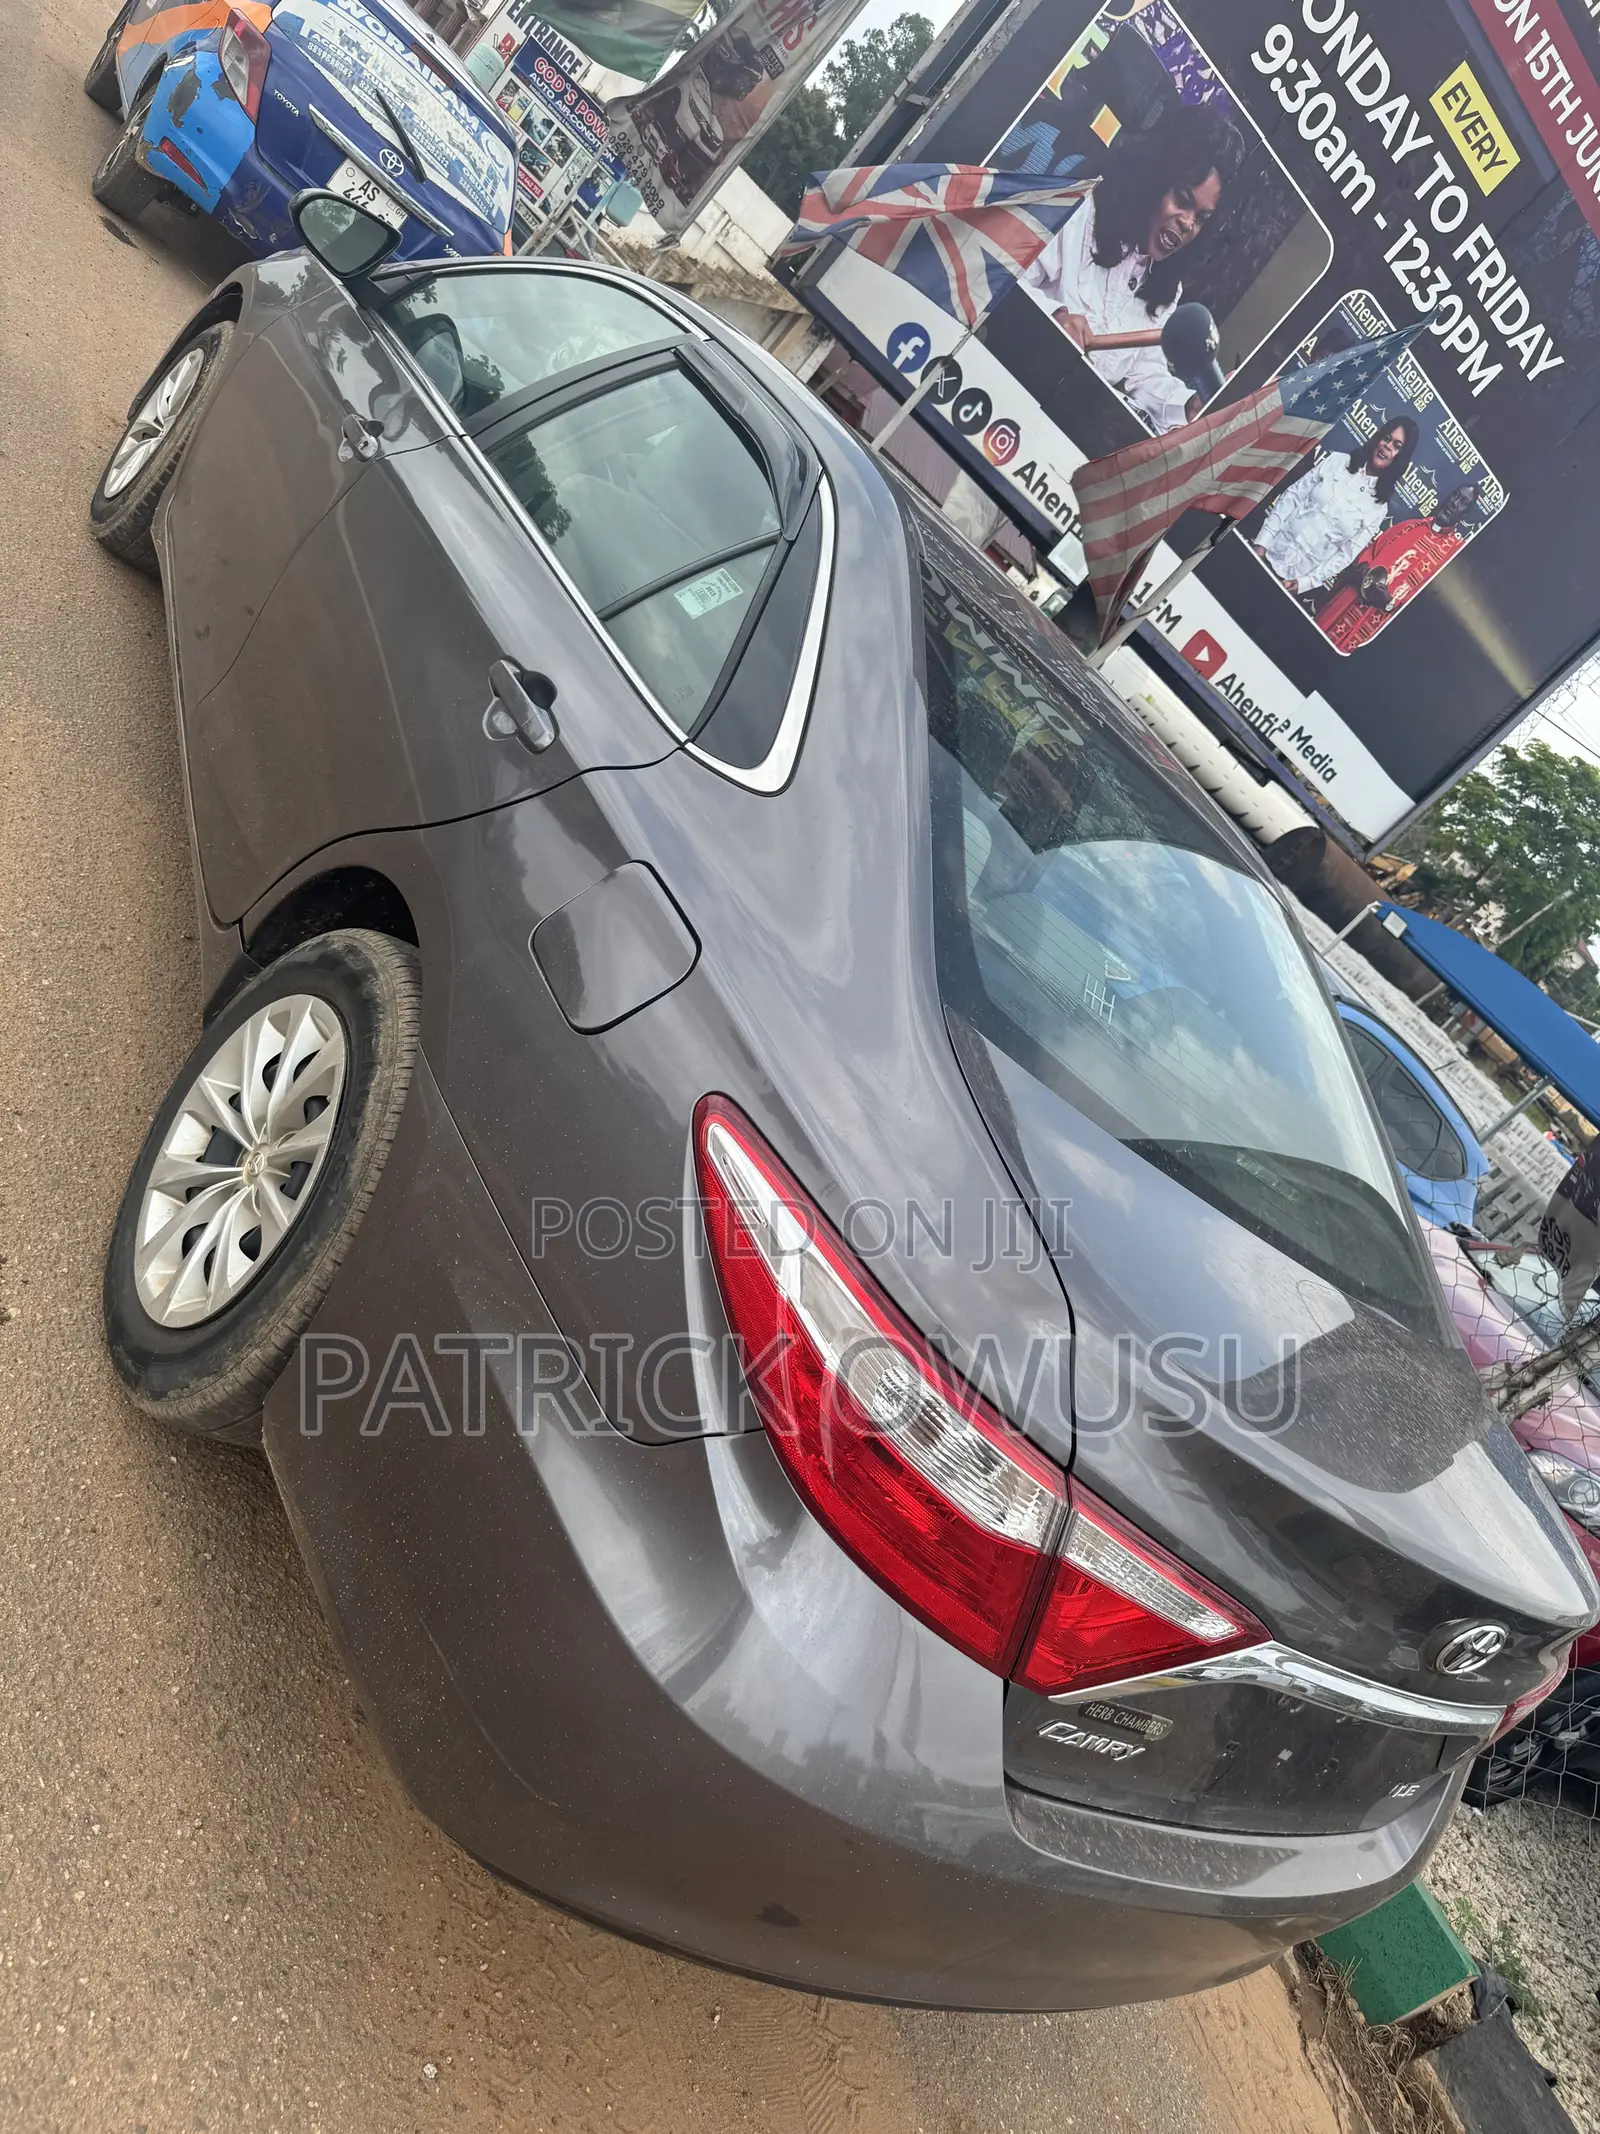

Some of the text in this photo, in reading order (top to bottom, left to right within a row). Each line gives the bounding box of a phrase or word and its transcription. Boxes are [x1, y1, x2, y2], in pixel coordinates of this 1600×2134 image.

[271, 88, 301, 118] TOYOTA
[311, 30, 355, 67] ACCRA
[361, 69, 406, 110] KUMASI
[411, 114, 457, 161] SUNYANI
[460, 167, 496, 209] OBUASI
[449, 107, 476, 136] LTD
[528, 71, 616, 163] AUTO AIR-CONDITON
[1441, 81, 1508, 173] EVERY
[1524, 29, 1582, 125] 15TH
[1566, 112, 1600, 204] JUN
[616, 130, 636, 154] 026
[357, 179, 381, 203] AS
[394, 207, 406, 220] GH
[1251, 23, 1504, 397] 9:30am - 12:30PM
[1301, 0, 1565, 382] ONDAY TO FRIDAY
[1347, 398, 1380, 438] Ahen
[1438, 417, 1481, 470] Ahenfie
[1290, 726, 1337, 783] Media
[1038, 1719, 1146, 1761] CAMRY
[1084, 1702, 1167, 1736] HERB CHAMBERS
